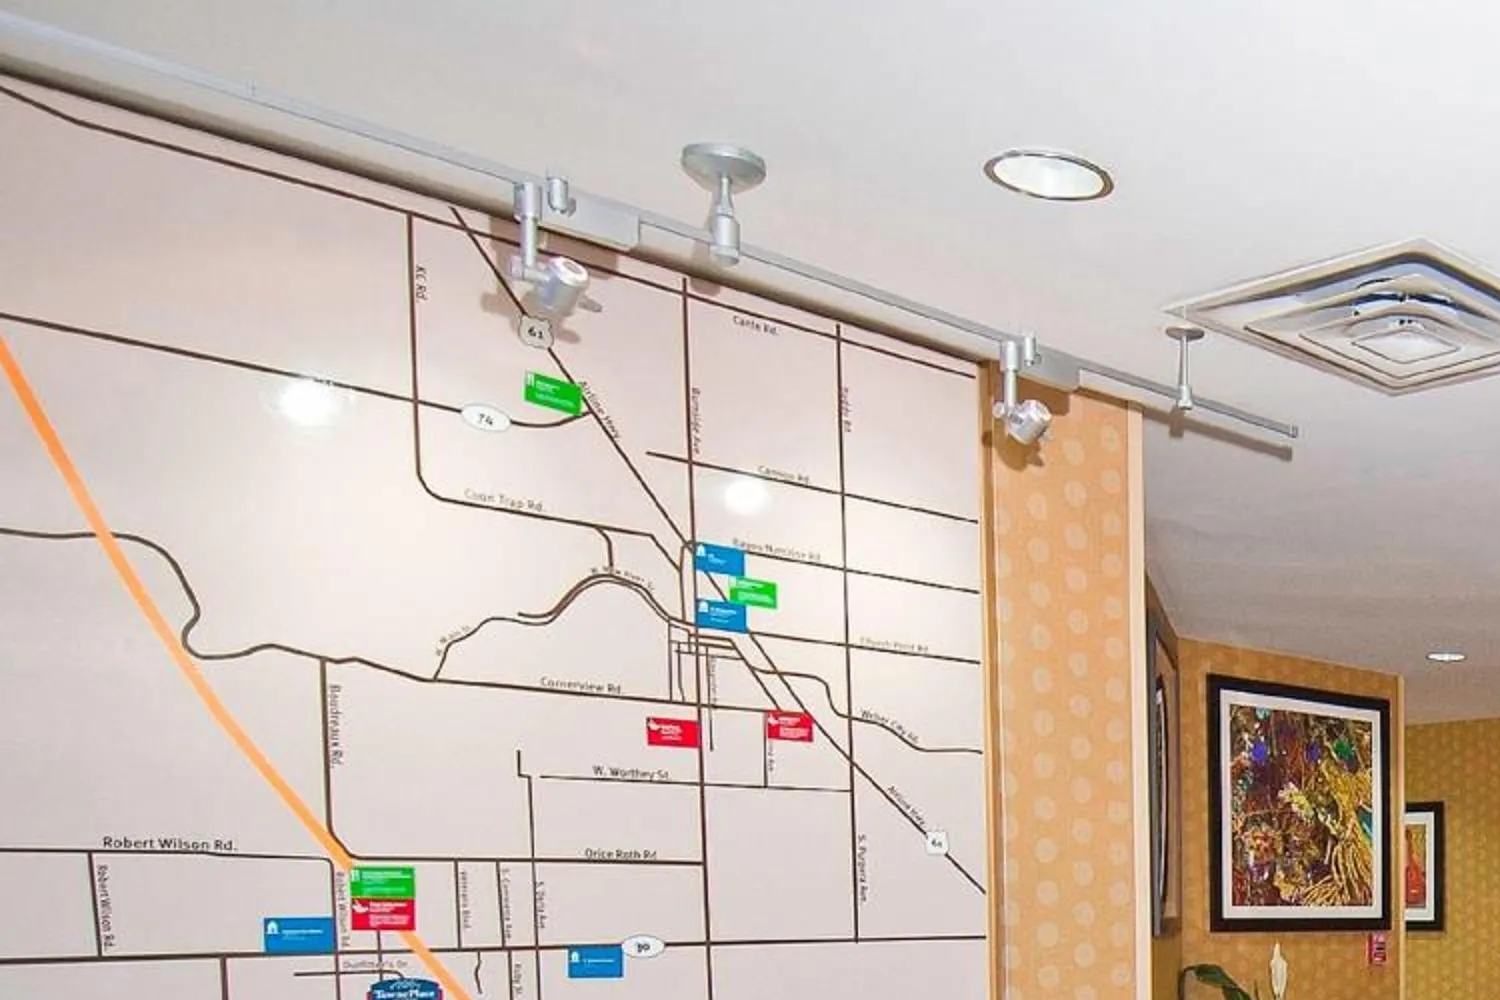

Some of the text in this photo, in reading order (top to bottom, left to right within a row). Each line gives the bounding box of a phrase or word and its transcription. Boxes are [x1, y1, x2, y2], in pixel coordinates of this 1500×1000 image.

[416, 265, 425, 281] KC
[478, 413, 494, 425] 74
[103, 836, 238, 851] Robert Wilson Rd.
